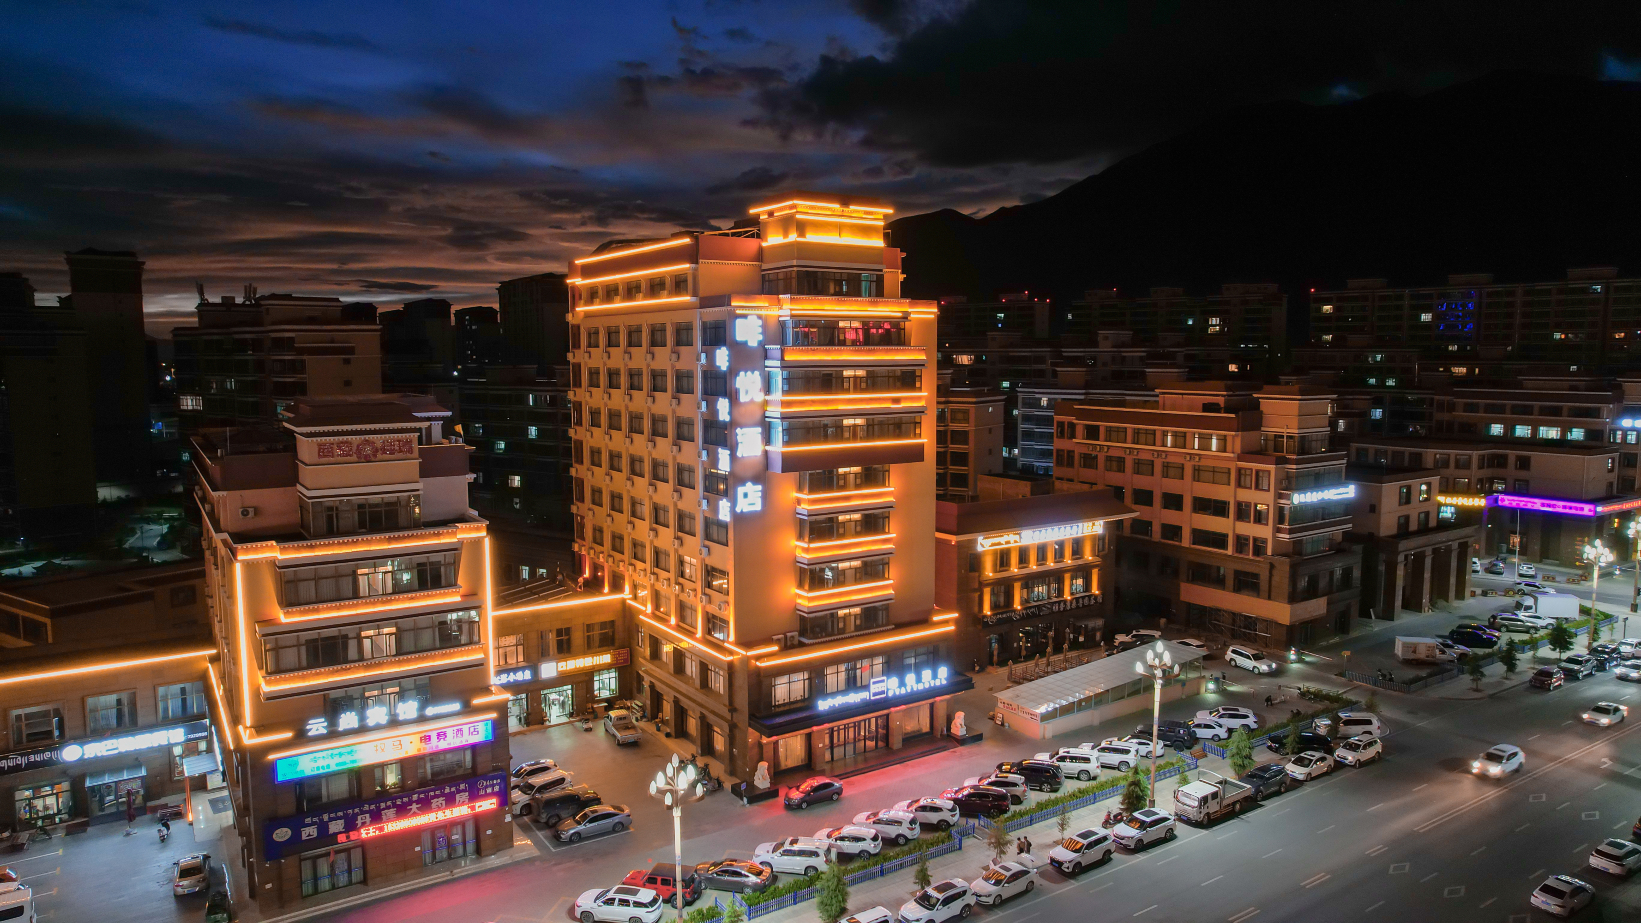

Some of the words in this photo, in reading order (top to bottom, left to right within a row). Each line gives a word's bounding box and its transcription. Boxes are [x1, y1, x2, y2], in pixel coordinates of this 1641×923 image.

[301, 792, 469, 840] 西藏丹莲大药房
